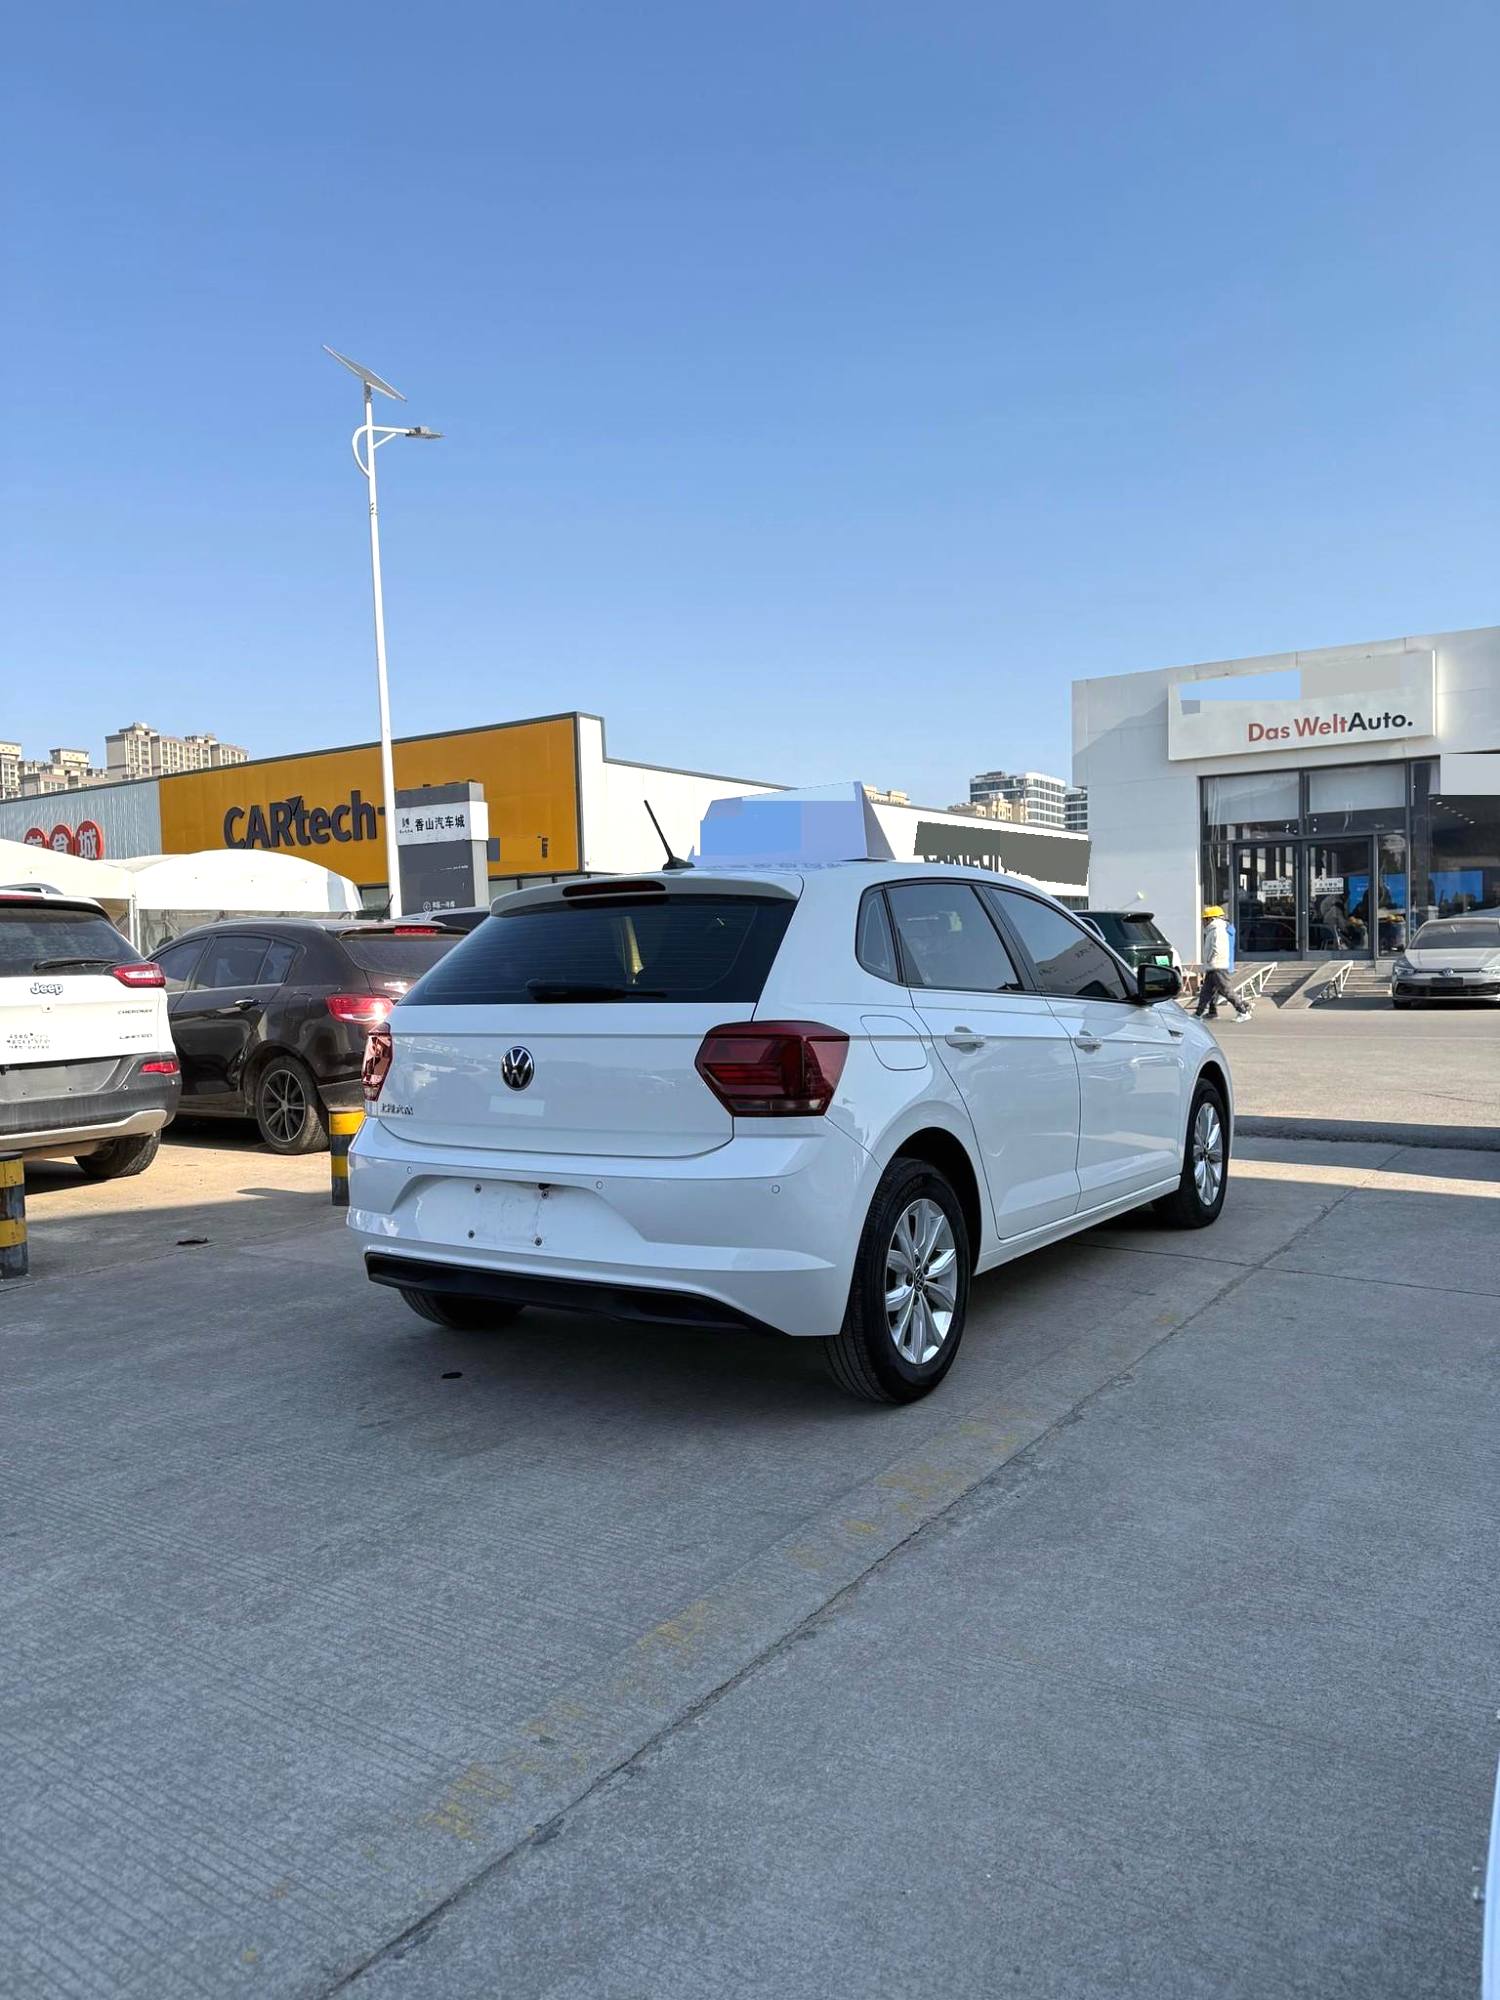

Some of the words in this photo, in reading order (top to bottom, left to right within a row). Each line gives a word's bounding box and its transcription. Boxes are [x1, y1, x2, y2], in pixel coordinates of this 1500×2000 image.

[1248, 722, 1290, 742] Das
[224, 789, 377, 849] CARtech
[415, 814, 465, 832] 香山汽车城
[30, 982, 63, 995] Jeep
